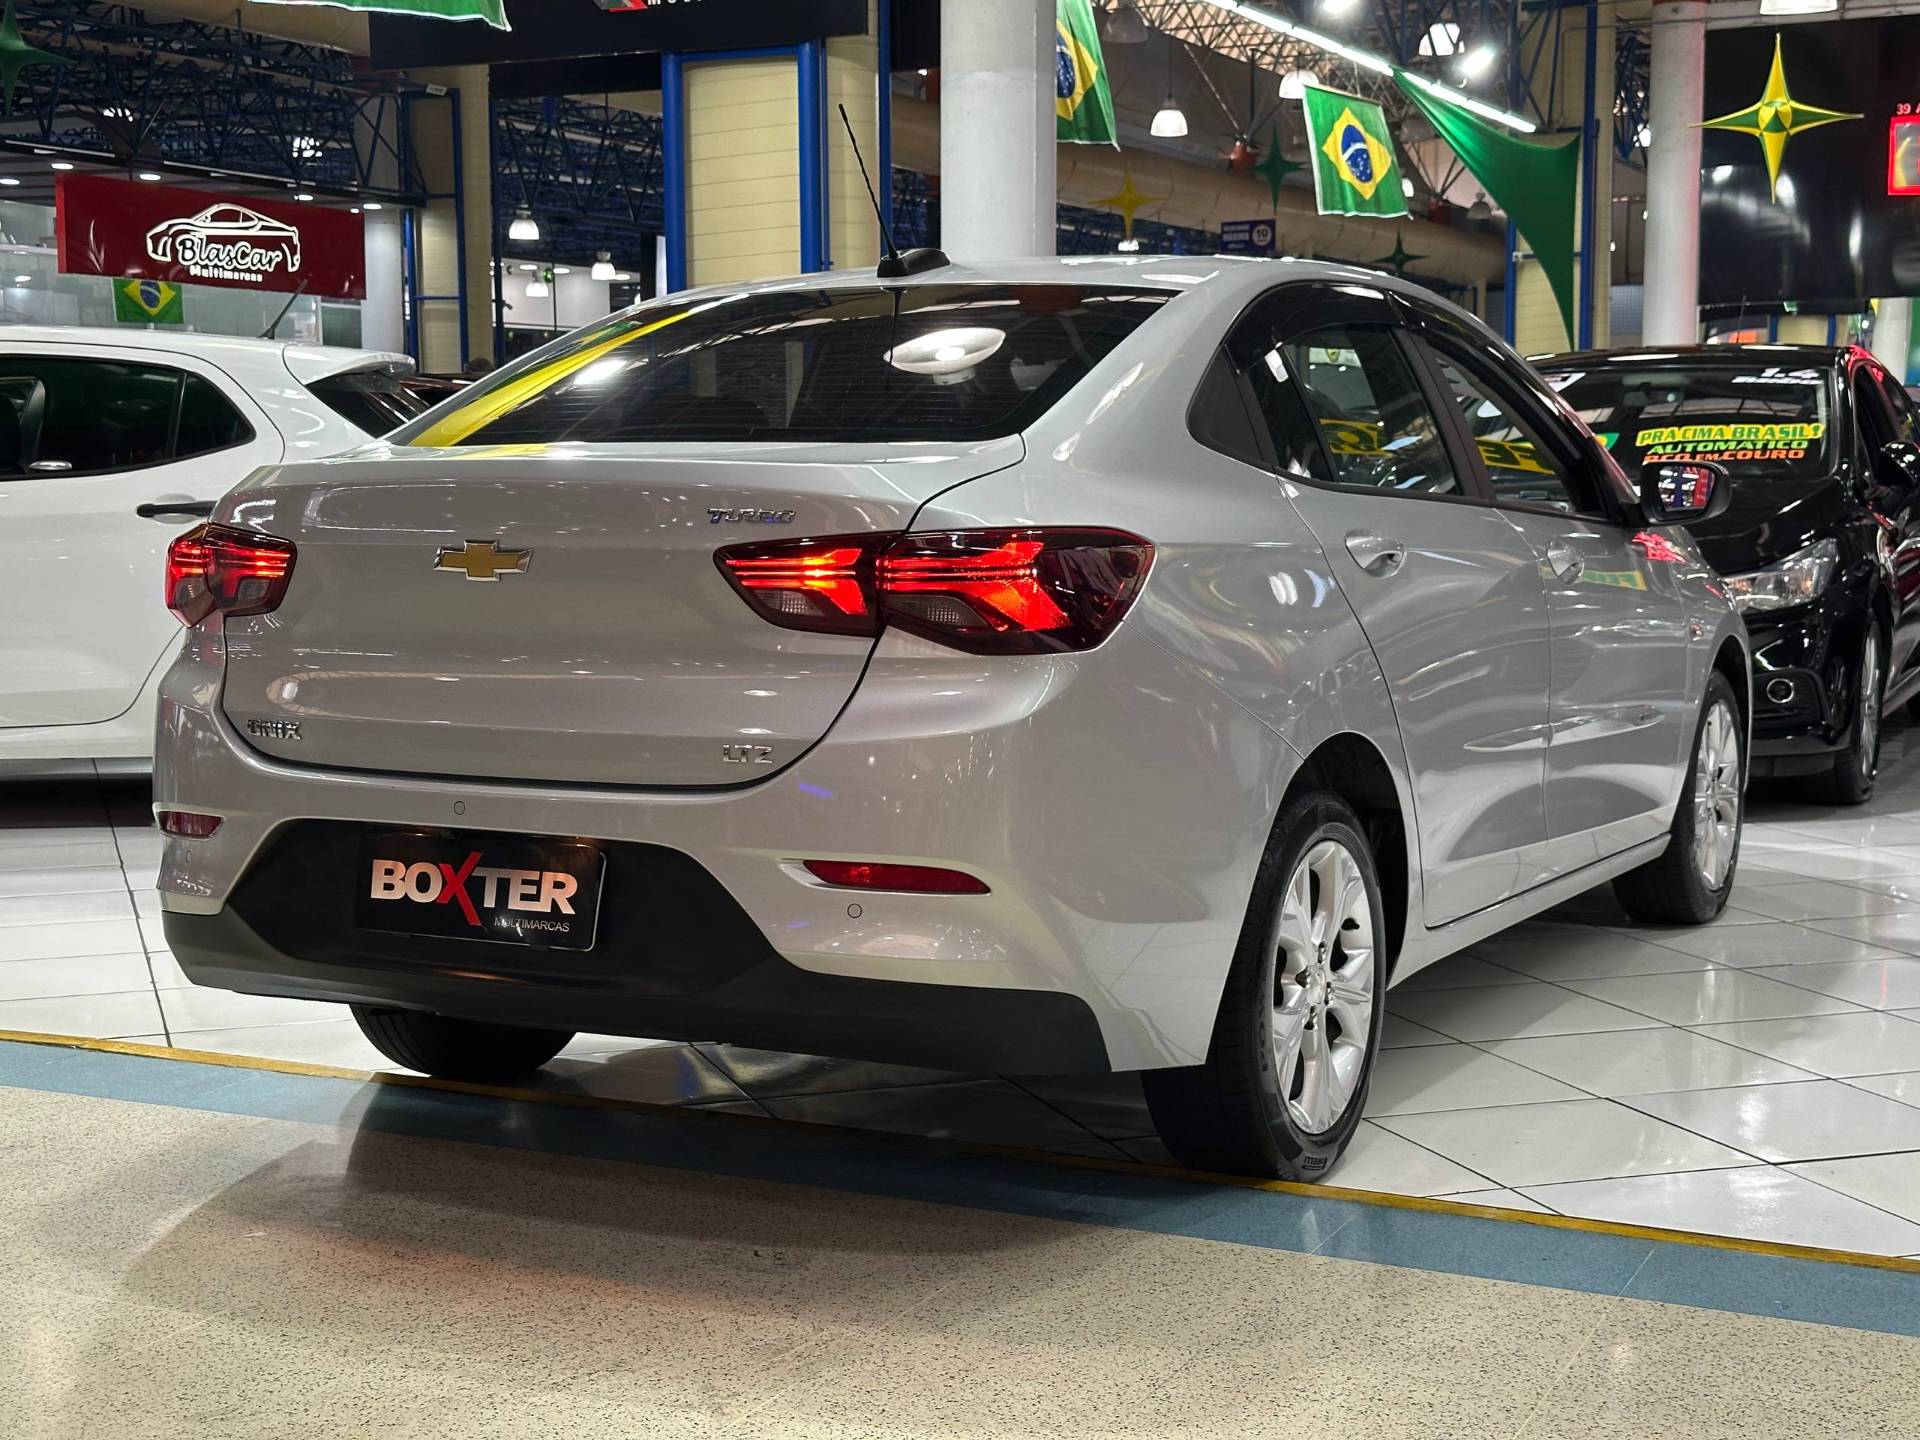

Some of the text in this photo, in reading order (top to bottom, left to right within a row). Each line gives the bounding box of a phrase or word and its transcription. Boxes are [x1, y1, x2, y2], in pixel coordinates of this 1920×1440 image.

[1896, 103, 1911, 115] 39
[176, 232, 283, 272] BlasCar
[189, 264, 263, 282] Multimarcas
[1637, 427, 1677, 445] PRA
[1680, 425, 1725, 441] CIMA
[1718, 450, 1805, 461] COURO
[707, 508, 795, 523] TURBO
[247, 719, 302, 740] ONIX
[723, 744, 773, 763] LTZ
[370, 851, 578, 926] BOXTER
[494, 917, 570, 933] MULTIMARCAS
